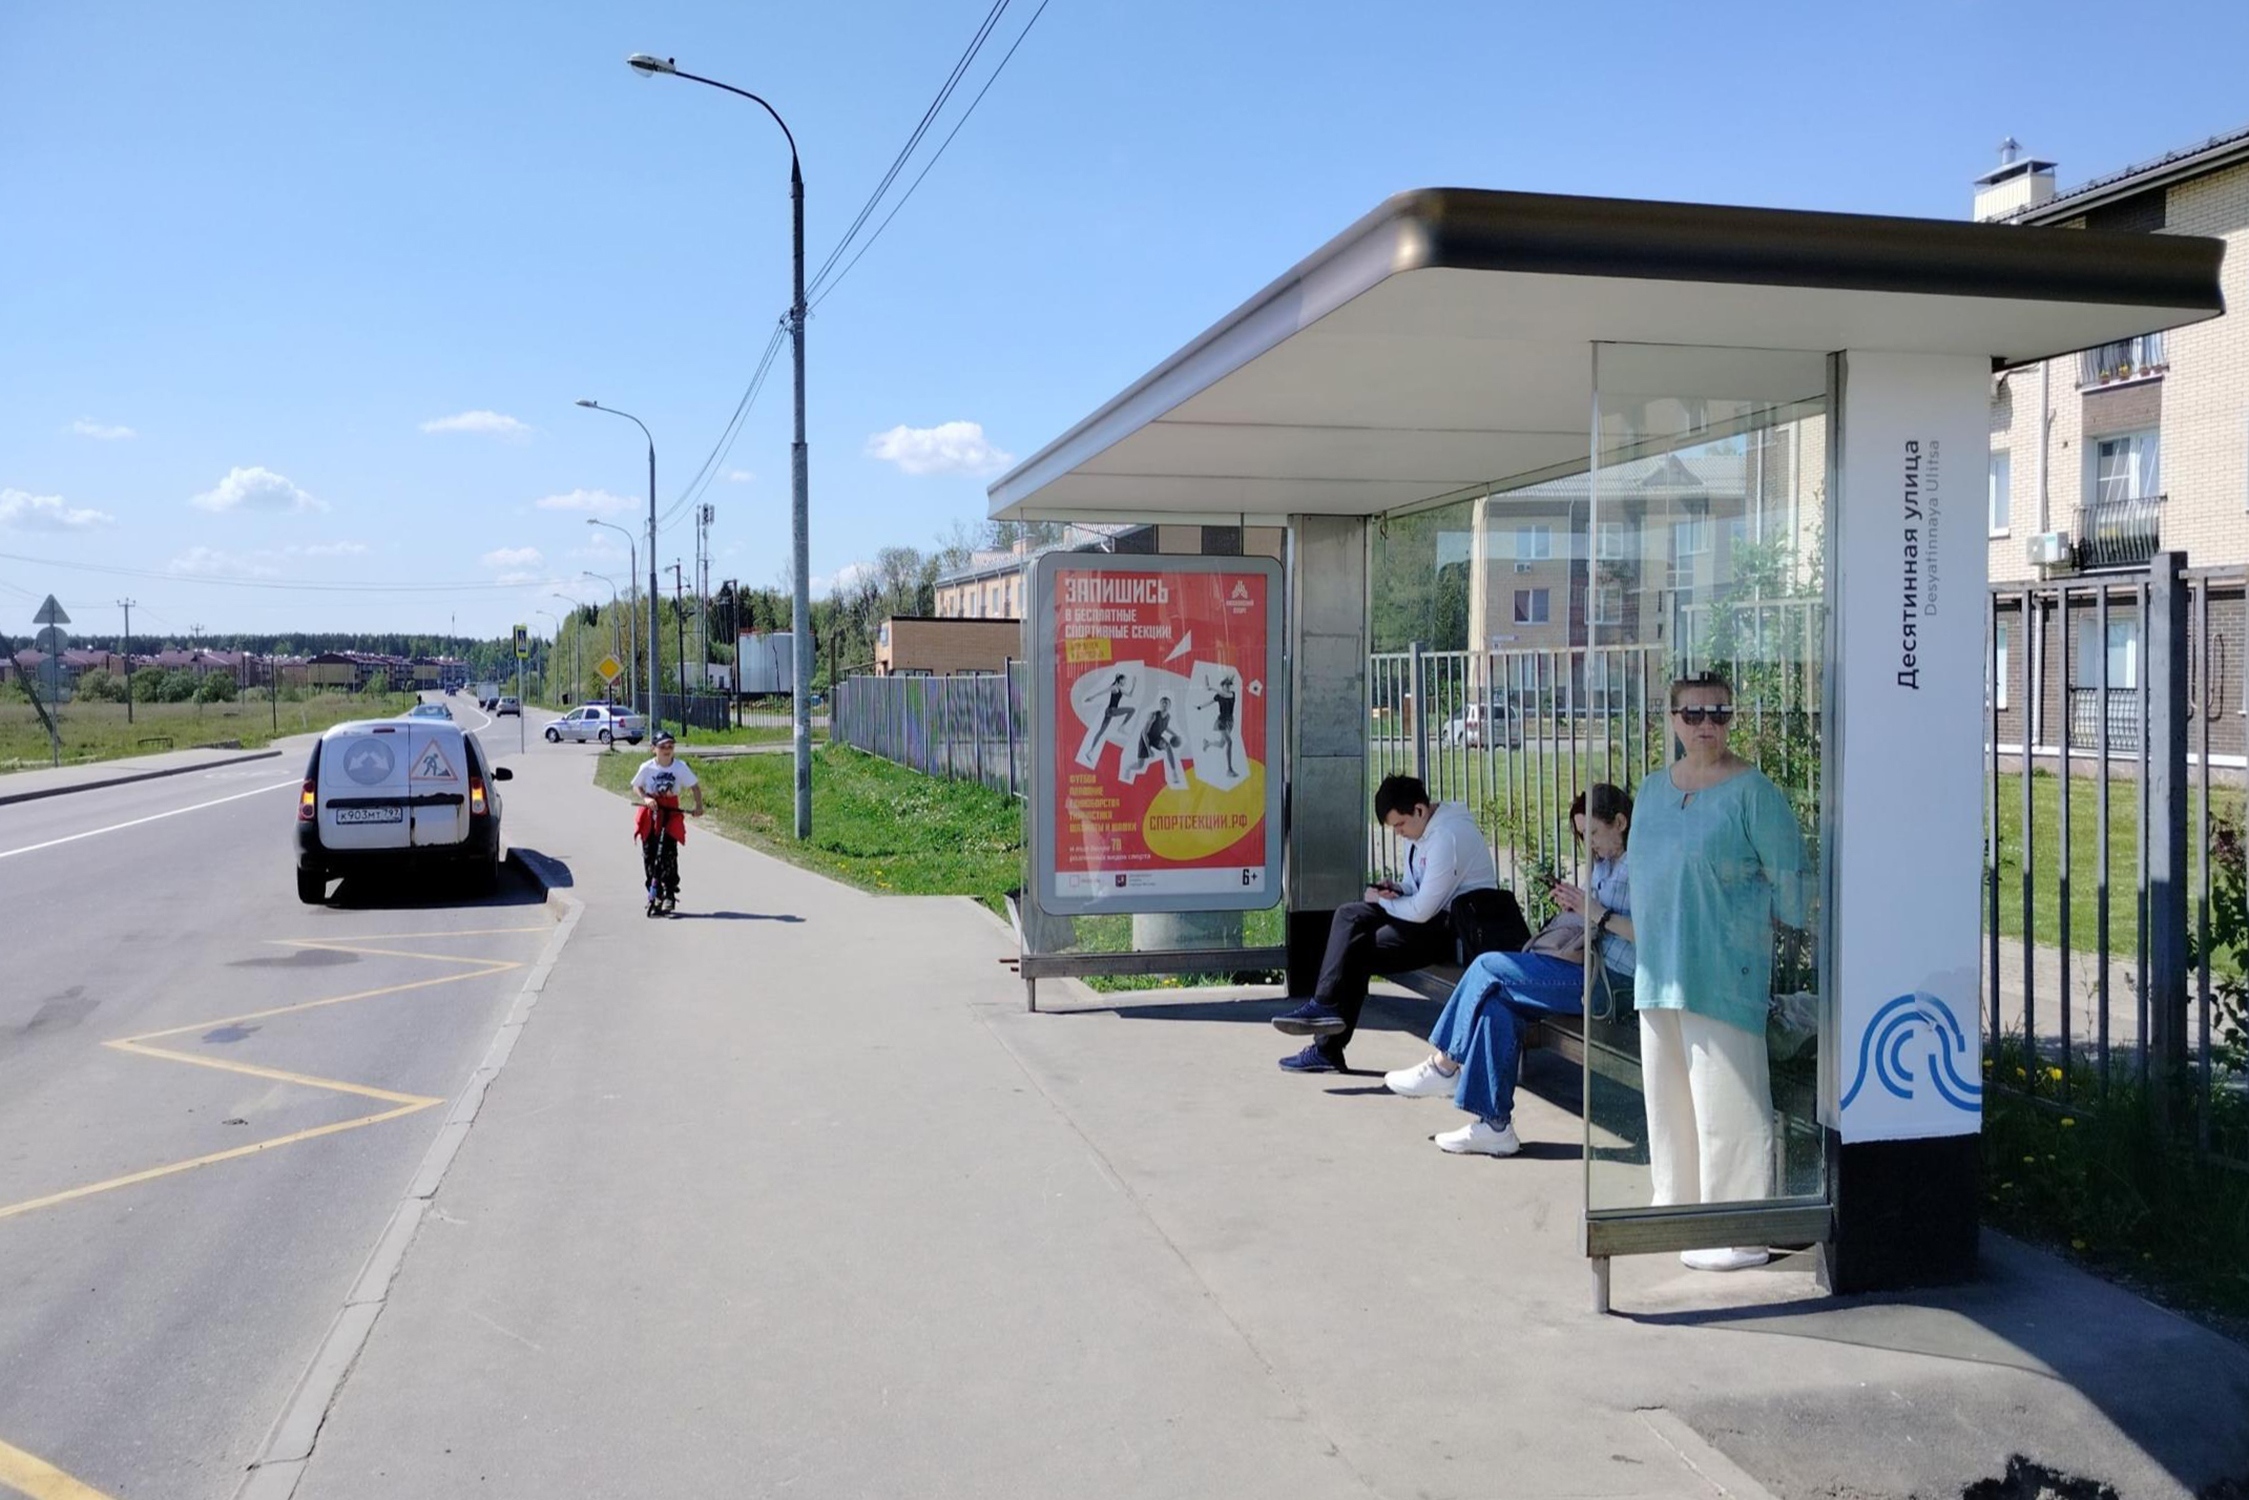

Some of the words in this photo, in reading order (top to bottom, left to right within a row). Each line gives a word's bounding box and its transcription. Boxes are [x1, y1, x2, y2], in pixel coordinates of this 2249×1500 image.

[1925, 440, 1940, 492] Ulitsa
[1904, 440, 1923, 521] улица
[1924, 497, 1942, 616] Desyatinnaya
[1064, 578, 1169, 604] ЗАПИШИСЬ
[1065, 608, 1072, 622] В
[1075, 608, 1137, 622] БЕСПЛАТНЫЕ
[1898, 528, 1919, 690] Десятинная
[1065, 625, 1129, 639] СПОРТИВНЫЕ
[1149, 814, 1248, 832] СПОРТСЕКЦИИ.РФ
[1242, 868, 1258, 886] 6+
